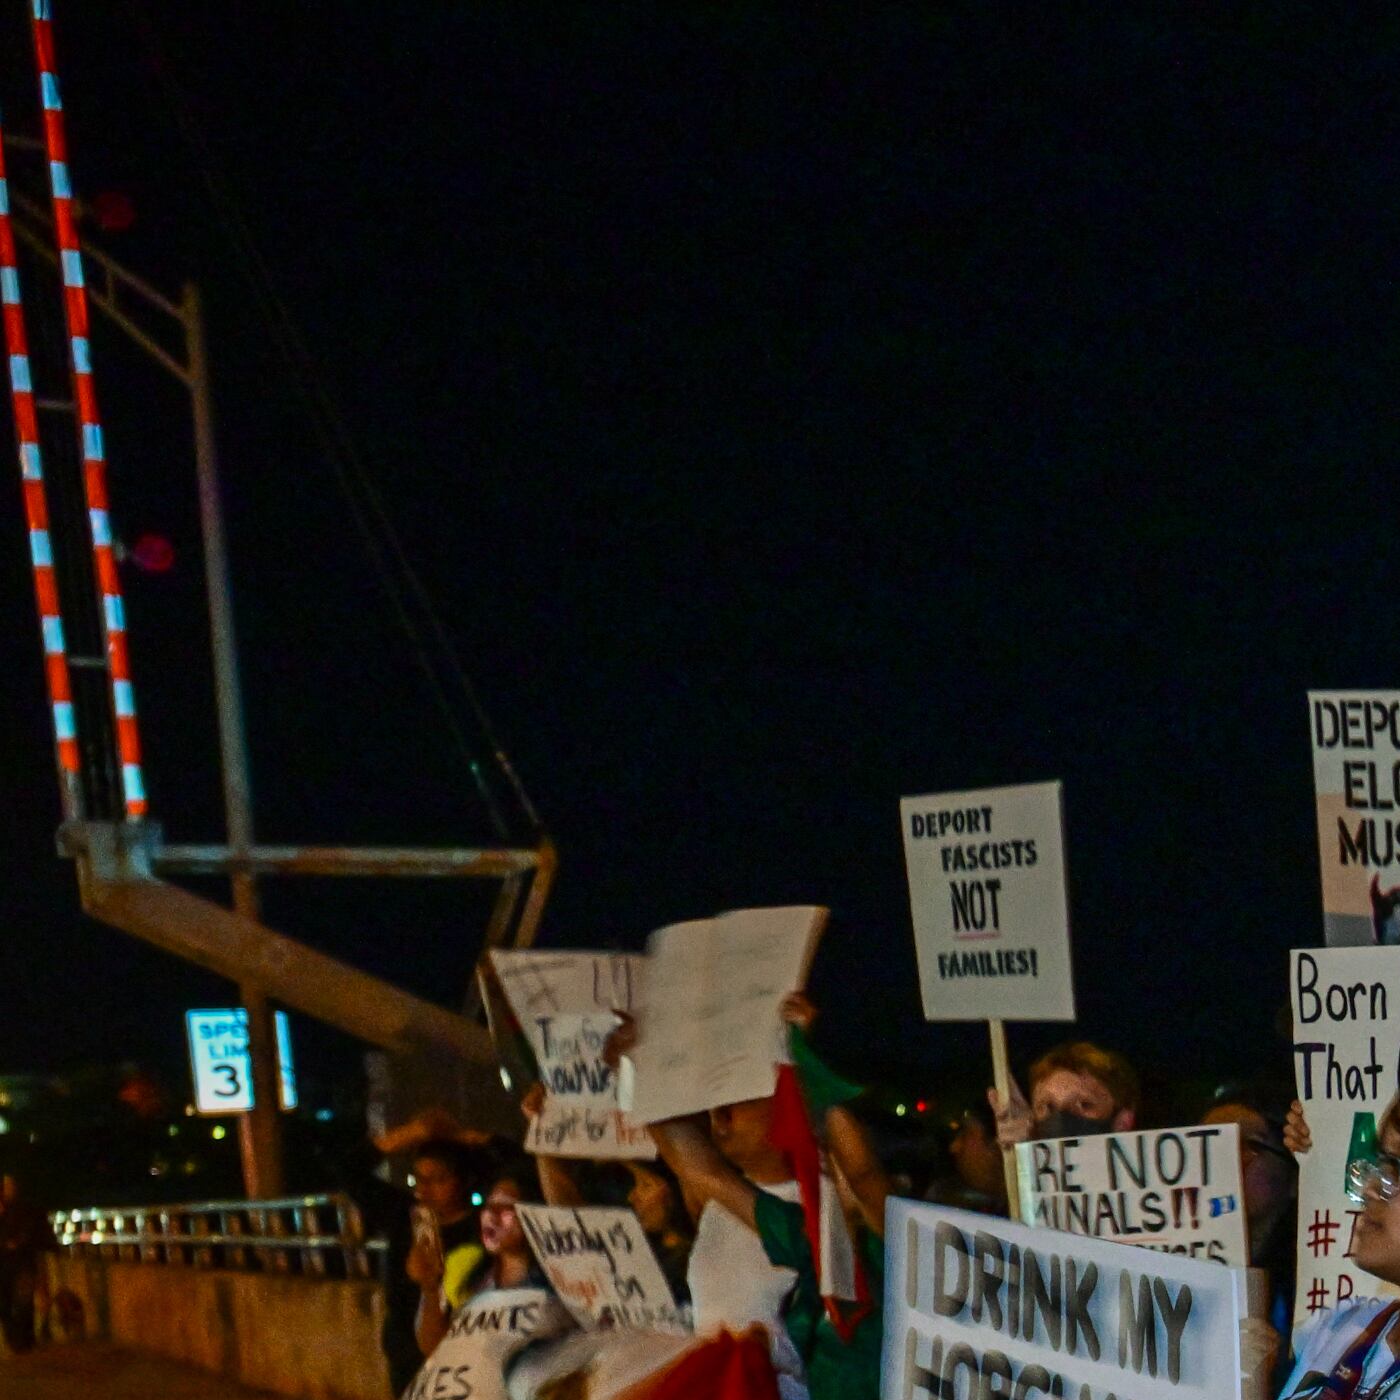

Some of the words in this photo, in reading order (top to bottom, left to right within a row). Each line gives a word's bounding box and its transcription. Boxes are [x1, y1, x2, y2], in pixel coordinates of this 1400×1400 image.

[911, 806, 992, 838] DEPORT
[941, 840, 1037, 872] FASCISTS
[950, 879, 1001, 931] NOT
[938, 950, 1038, 979] FAMILIES!
[1299, 953, 1387, 1024] Born
[1294, 1037, 1383, 1101] That
[1105, 1129, 1220, 1191] NOT
[906, 1216, 920, 1310] I
[933, 1219, 1101, 1362] DRINK
[1117, 1268, 1193, 1386] MY
